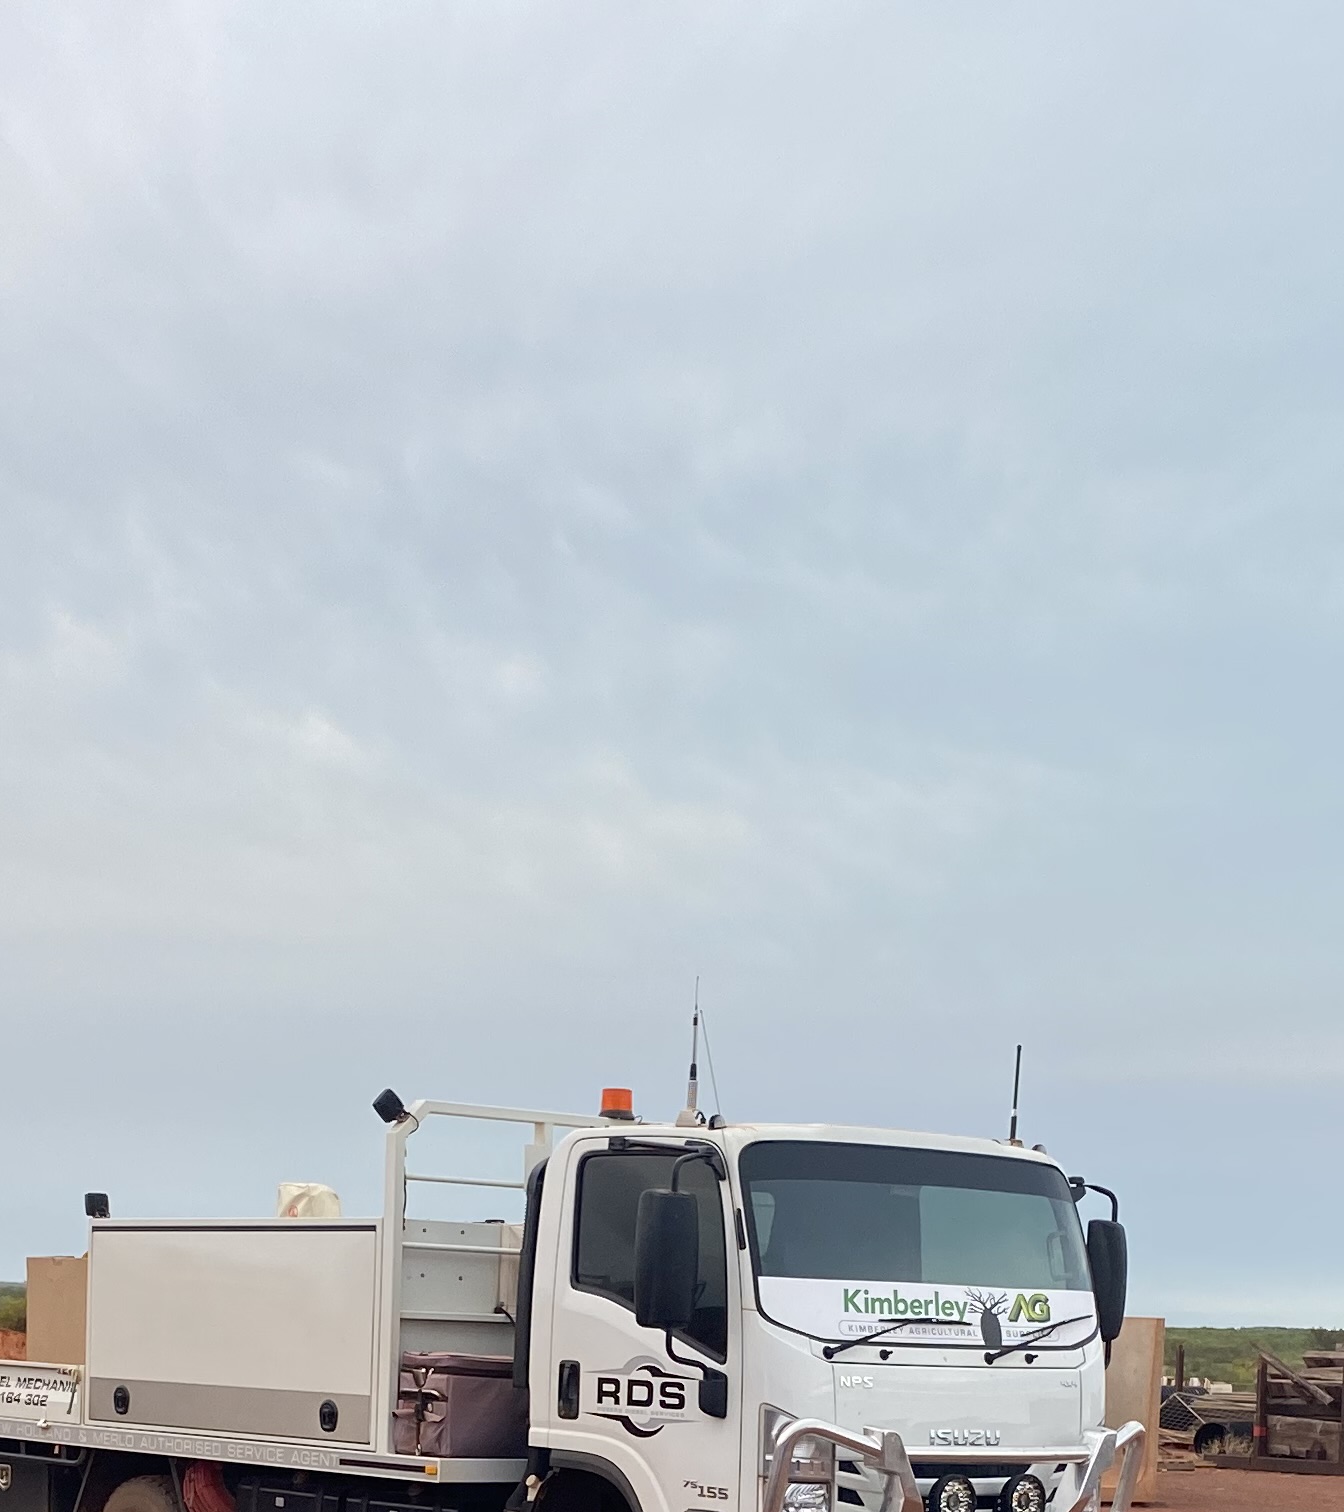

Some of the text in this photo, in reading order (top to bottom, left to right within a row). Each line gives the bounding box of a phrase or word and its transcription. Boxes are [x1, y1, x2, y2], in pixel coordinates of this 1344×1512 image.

[843, 1288, 1052, 1323] Kimberley AG
[909, 1326, 978, 1338] AGRICULTURAL
[840, 1375, 874, 1388] NPS
[24, 1393, 49, 1407] 302
[596, 1377, 686, 1410] RDS
[929, 1428, 1001, 1446] ISUZU
[16, 1424, 72, 1441] HOLLAND
[78, 1430, 87, 1443] &
[93, 1431, 135, 1448] MERLO
[139, 1436, 222, 1456] AUTHORISED
[227, 1443, 285, 1463] SERVICE
[290, 1450, 339, 1467] AGENT
[697, 1485, 729, 1500] 155
